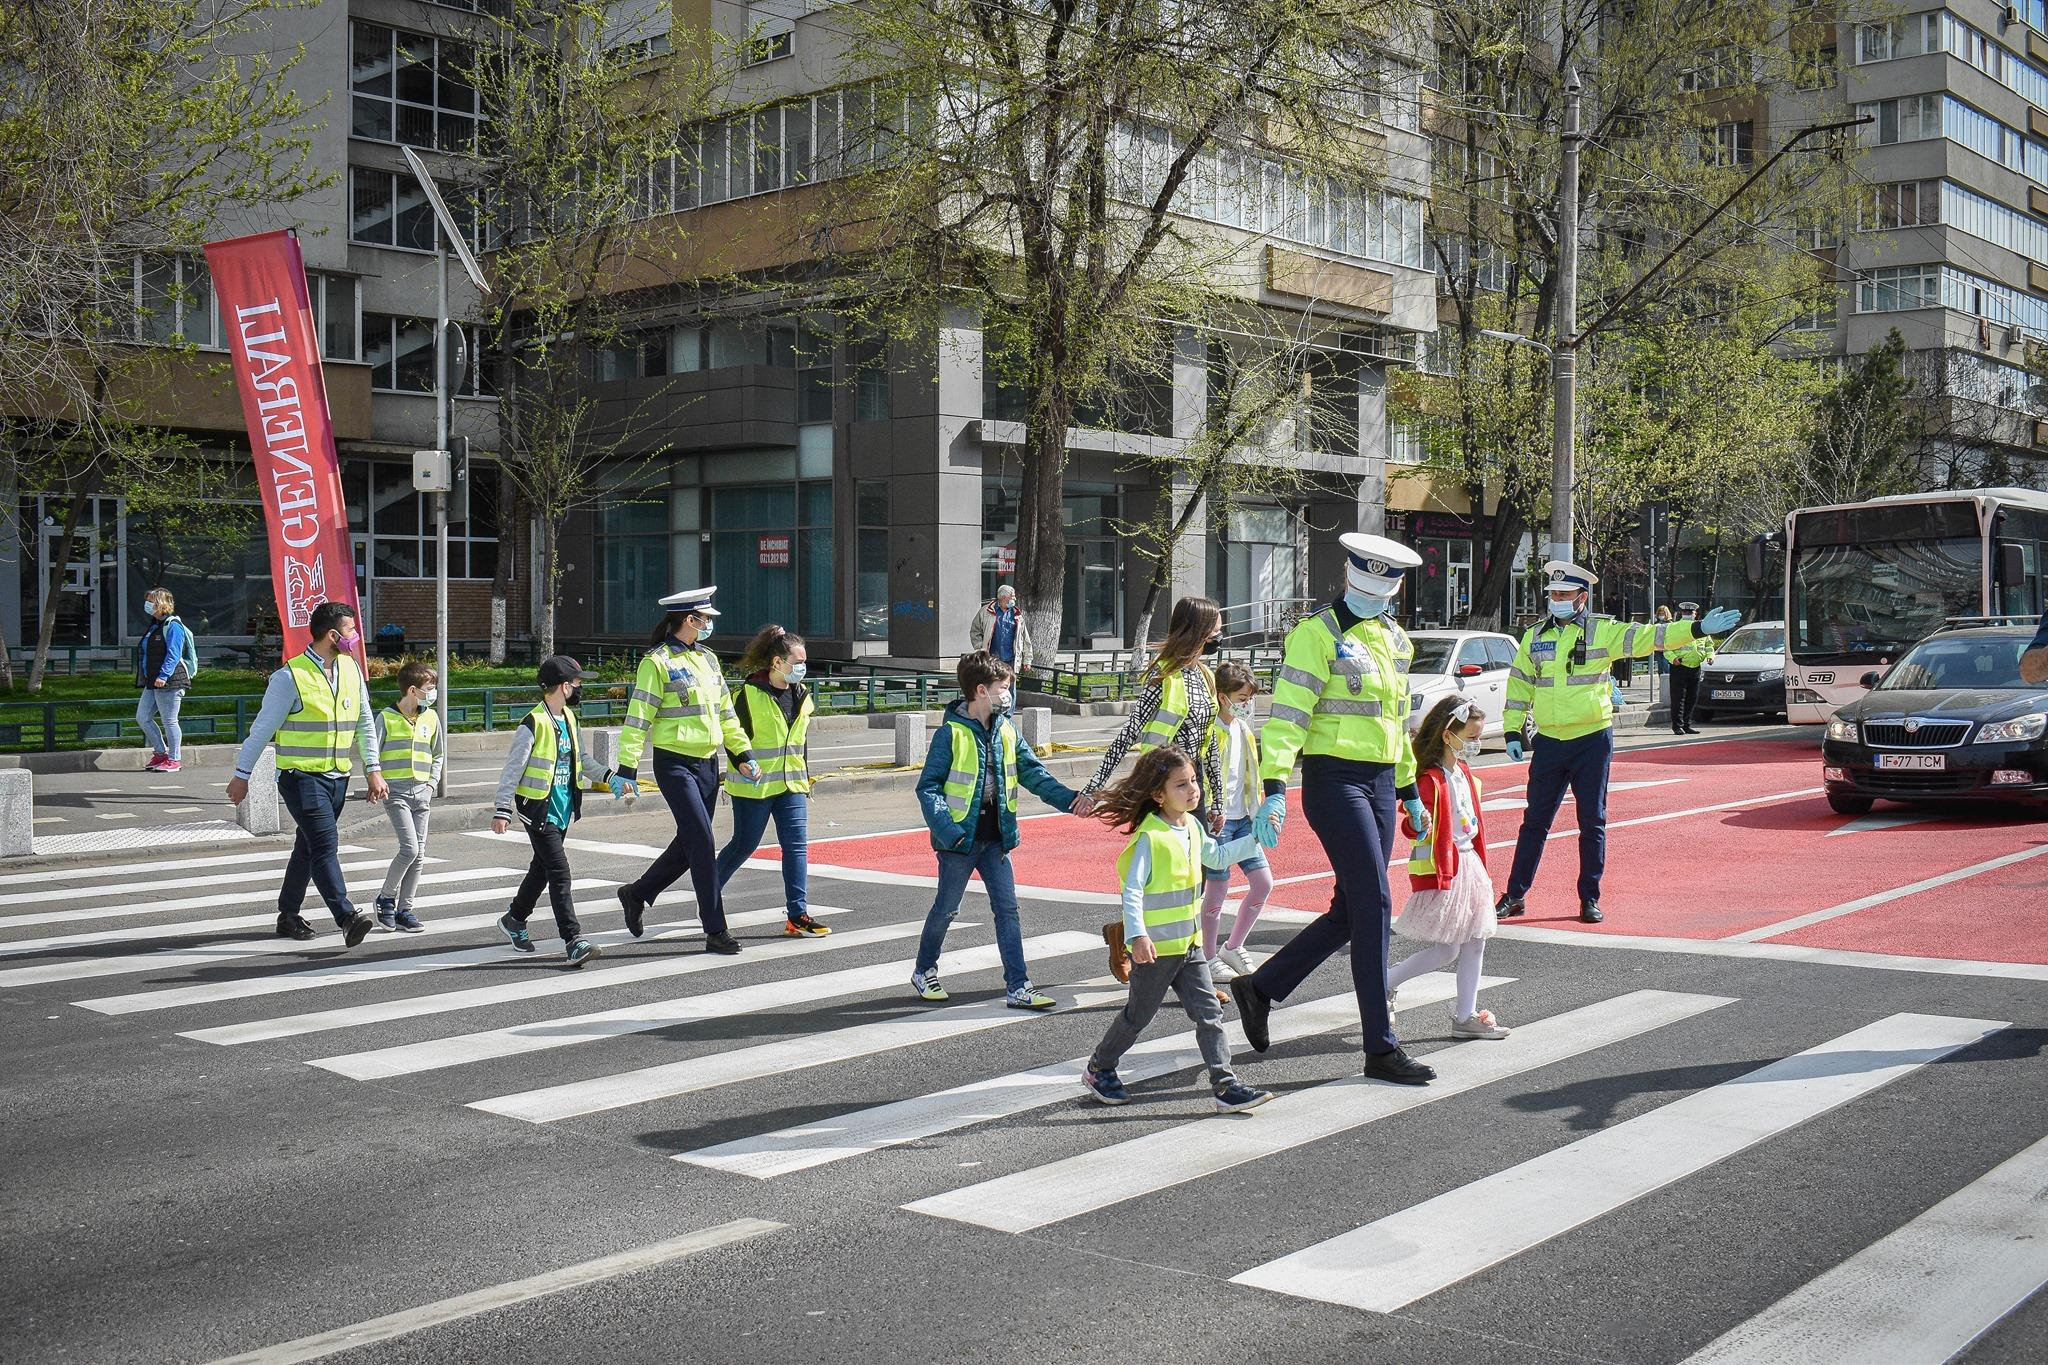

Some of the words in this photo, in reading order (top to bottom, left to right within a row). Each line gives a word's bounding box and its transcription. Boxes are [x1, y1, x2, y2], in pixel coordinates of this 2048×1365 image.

[1384, 514, 1406, 530] RIE
[1785, 675, 1799, 687] 816
[1808, 673, 1834, 683] STB
[1882, 755, 1894, 767] IF
[1897, 755, 1912, 767] 77
[1917, 755, 1942, 768] TCM
